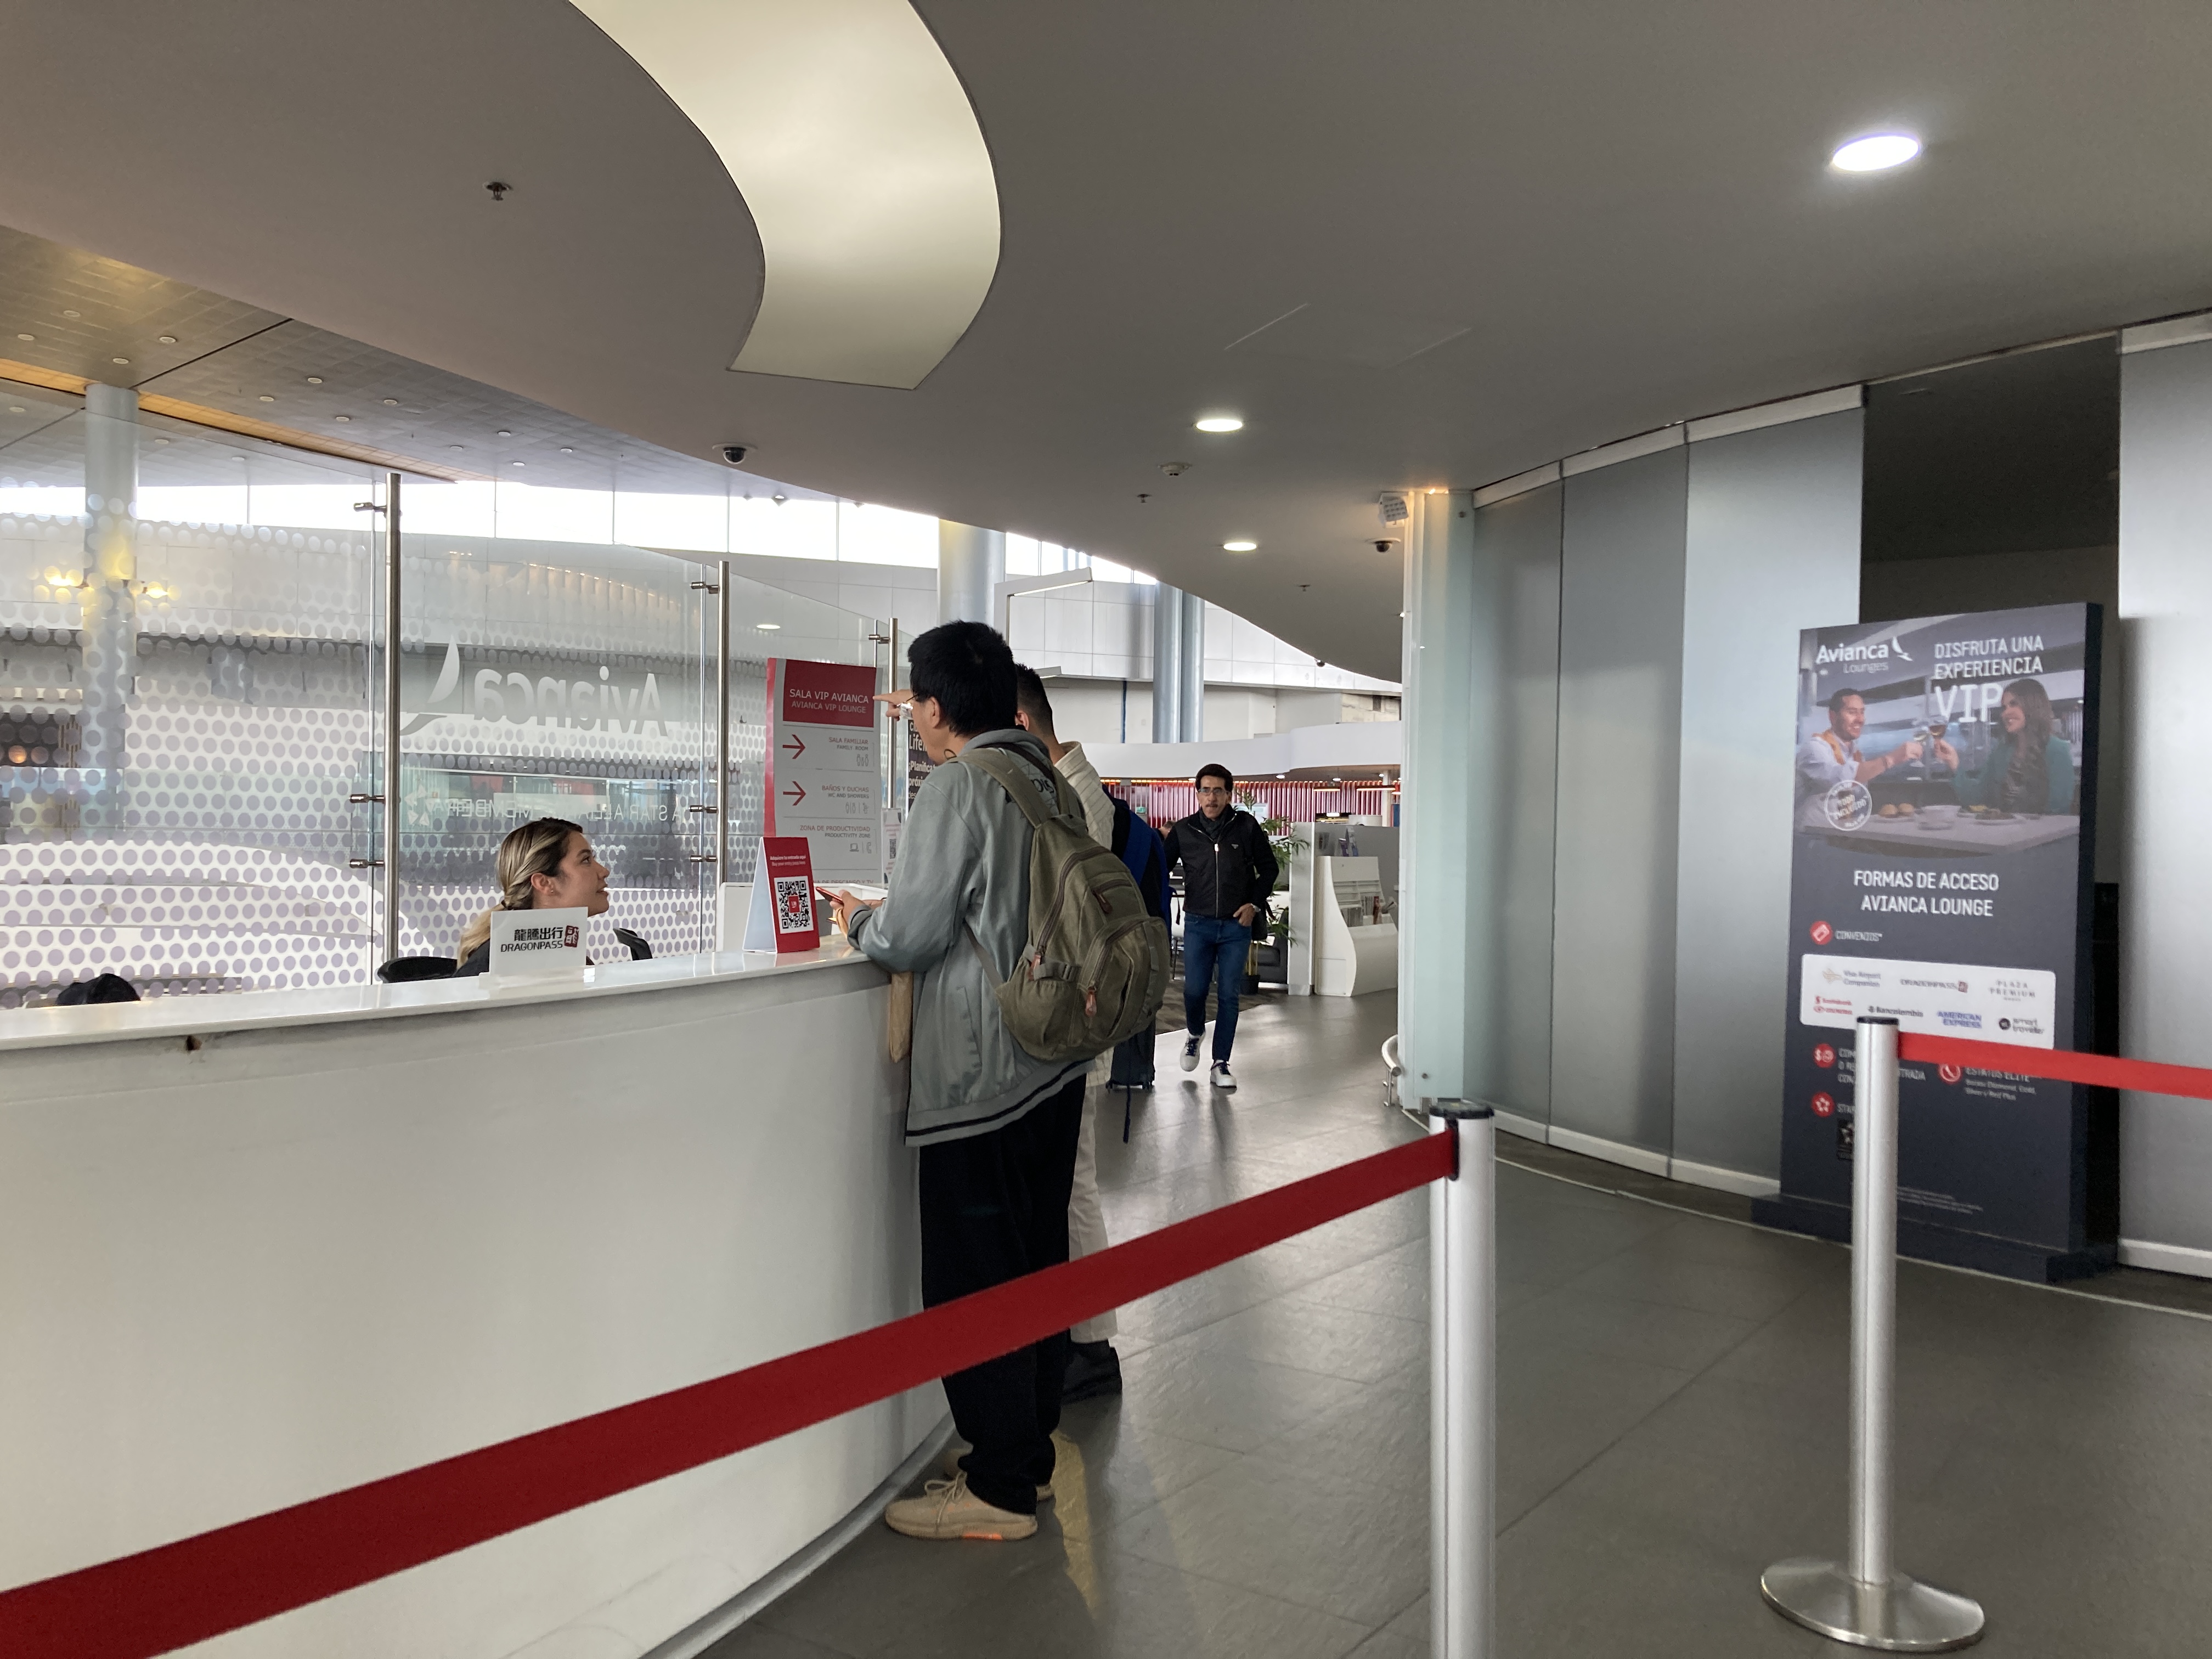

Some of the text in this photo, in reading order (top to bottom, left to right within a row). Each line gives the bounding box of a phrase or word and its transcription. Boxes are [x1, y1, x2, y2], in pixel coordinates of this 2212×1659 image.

[1815, 642, 1889, 665] Avianca
[1934, 635, 2045, 659] DISFRUTA UNA
[1843, 662, 1889, 674] Lounges
[1933, 656, 2044, 680] EXPERIENCIA
[789, 689, 869, 704] SALA VIP AVIANCA
[1934, 682, 2003, 723] VIP
[791, 701, 823, 710] AVIANCA
[838, 704, 867, 713] LOUNGE
[909, 775, 924, 788] próxi
[1853, 870, 2000, 891] FORMAS DE ACCESO
[1860, 894, 1994, 917] AVIANCA LOUNGE
[500, 940, 563, 953] DRAGONPASS
[1996, 979, 2028, 989] PLAZA
[1989, 987, 2036, 998] PREMIUM
[1937, 1010, 1982, 1022] AMERICAN
[1943, 1018, 1983, 1029] EXPRESS
